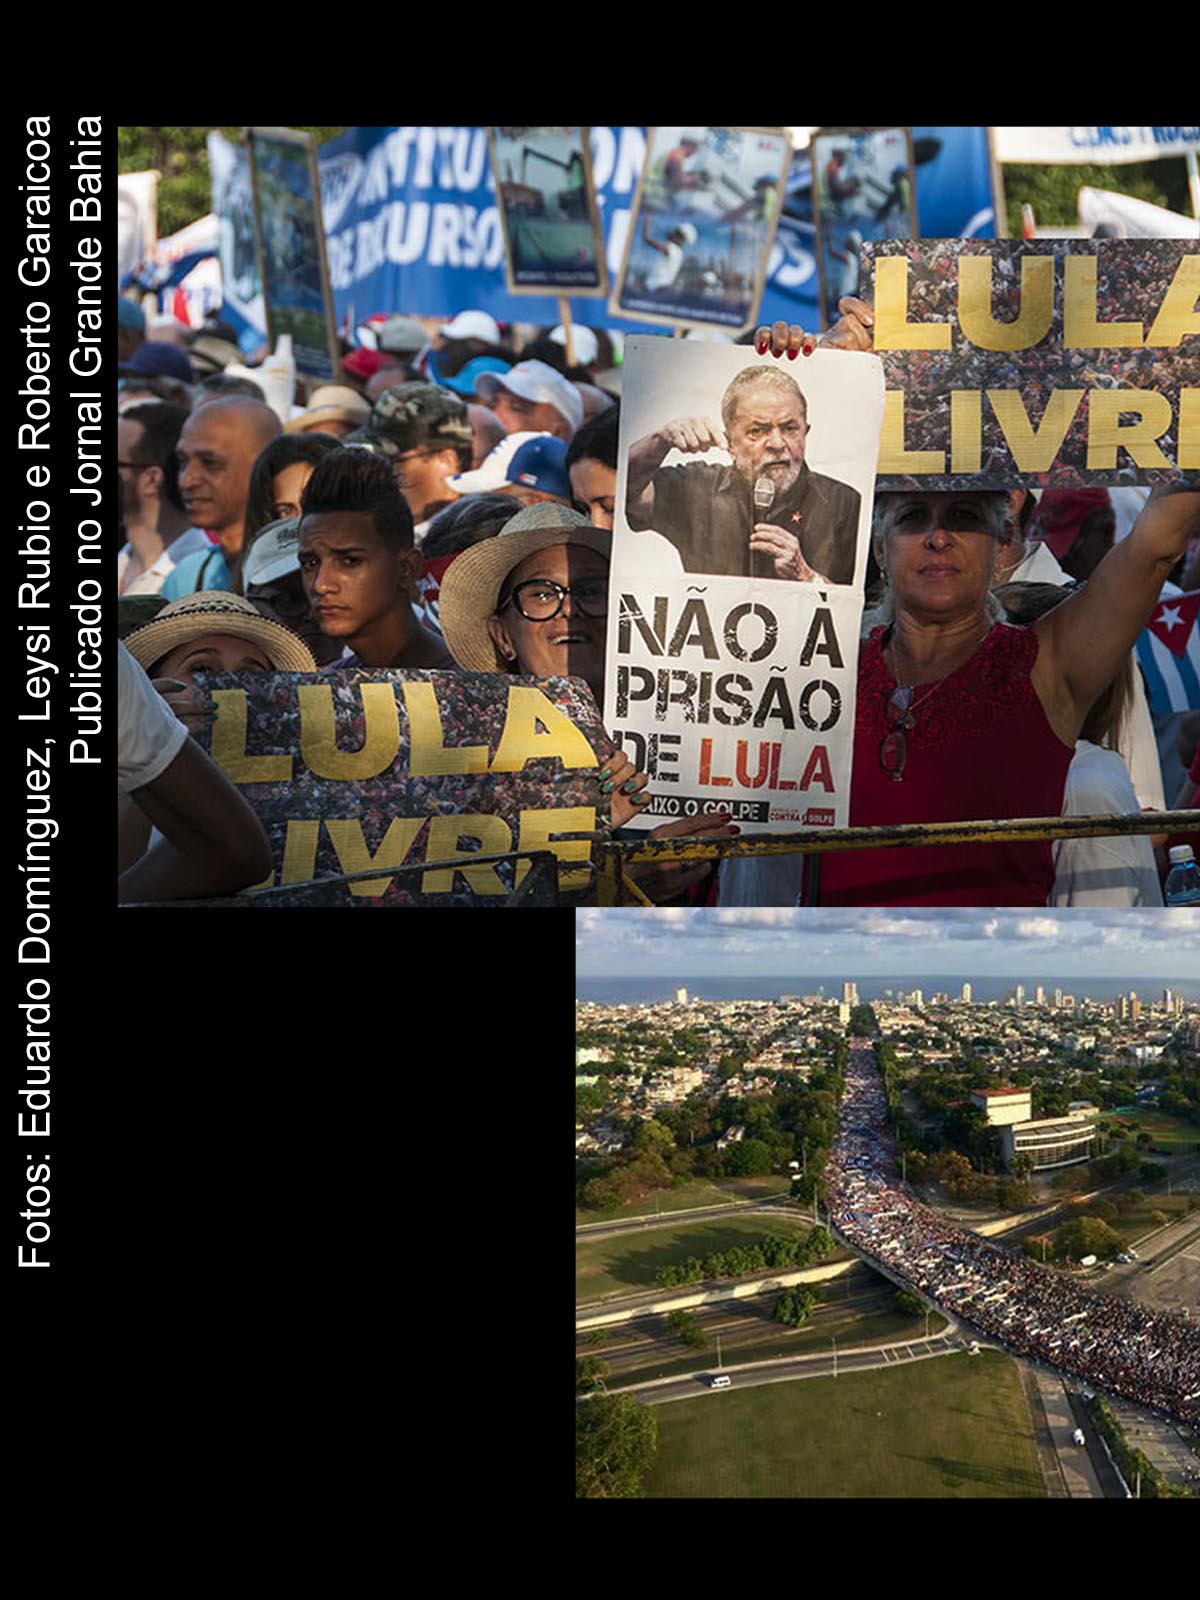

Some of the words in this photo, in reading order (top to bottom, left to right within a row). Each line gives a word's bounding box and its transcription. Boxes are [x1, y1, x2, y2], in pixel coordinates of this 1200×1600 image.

[616, 585, 779, 663] NÃO
[800, 592, 845, 669] À
[210, 680, 600, 784] LULA
[615, 665, 842, 732] PRISÃO
[613, 729, 682, 783] DE
[697, 737, 835, 793] LULA
[641, 796, 680, 816] AIXO
[684, 799, 698, 816] O
[703, 801, 760, 820] GOLPE
[253, 806, 597, 898] IVRE
